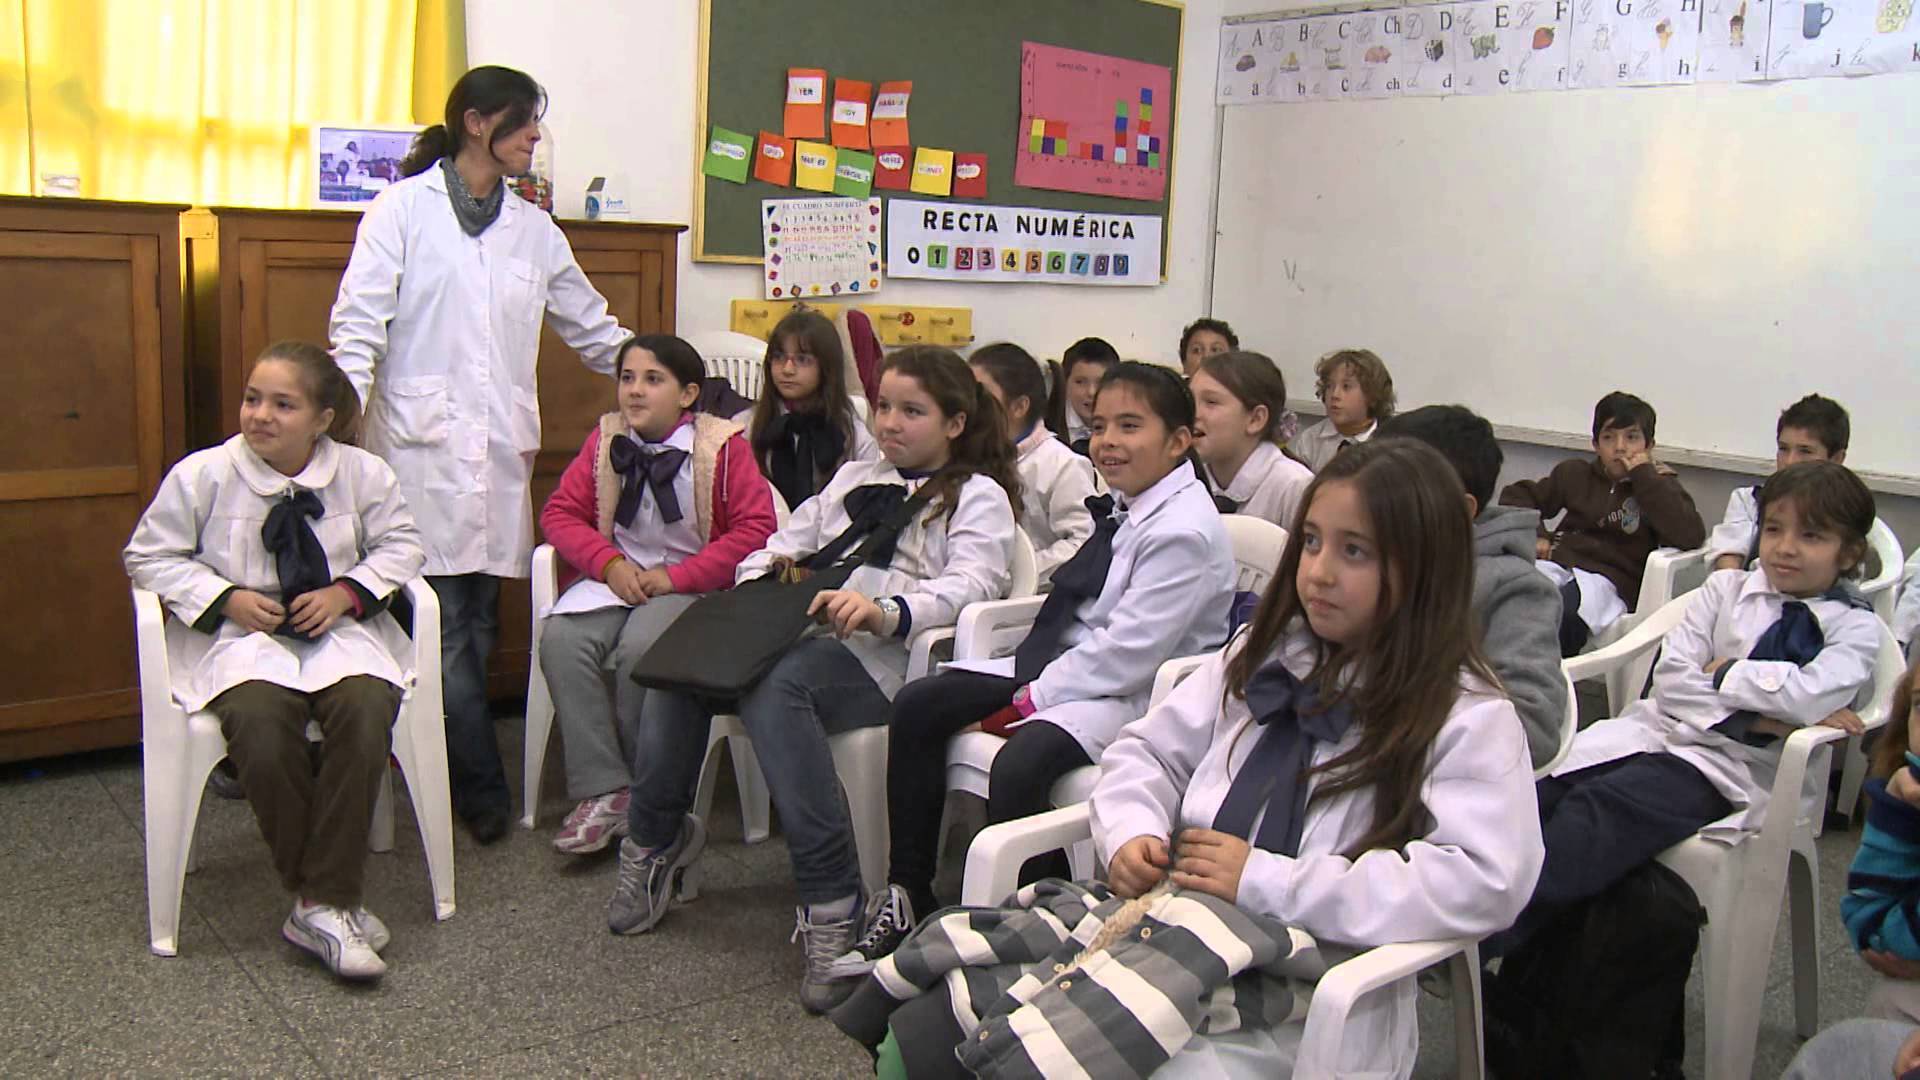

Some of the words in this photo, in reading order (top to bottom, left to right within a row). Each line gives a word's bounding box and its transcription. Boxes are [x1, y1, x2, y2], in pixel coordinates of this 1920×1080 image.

[1252, 29, 1263, 47] A
[1299, 23, 1309, 42] B
[1338, 21, 1350, 39] C
[1384, 15, 1401, 34] Ch
[1440, 11, 1452, 31] D
[1495, 5, 1510, 28] E
[1555, 1, 1568, 21] F
[1616, 0, 1632, 16] G
[1252, 82, 1259, 96] a
[1297, 81, 1306, 94] b
[1341, 78, 1349, 92] c
[1386, 78, 1400, 90] ch
[1442, 74, 1452, 88] d
[1499, 69, 1509, 85] e
[1558, 68, 1566, 82] f
[1618, 63, 1628, 78] g
[1678, 59, 1690, 76] h
[1754, 56, 1760, 72] i
[1830, 48, 1841, 67] j
[1912, 43, 1920, 62] k
[923, 209, 999, 232] RECTA
[1016, 213, 1135, 239] NUMÉRICA
[908, 247, 920, 264] 0
[934, 249, 941, 265] 1
[960, 250, 970, 266] 2
[983, 251, 992, 266] 3
[1006, 252, 1016, 268] 4
[1031, 254, 1039, 270] 5
[1052, 255, 1062, 270] 6
[1076, 256, 1086, 271] 7
[1098, 257, 1106, 273] 8
[1117, 257, 1125, 273] 9
